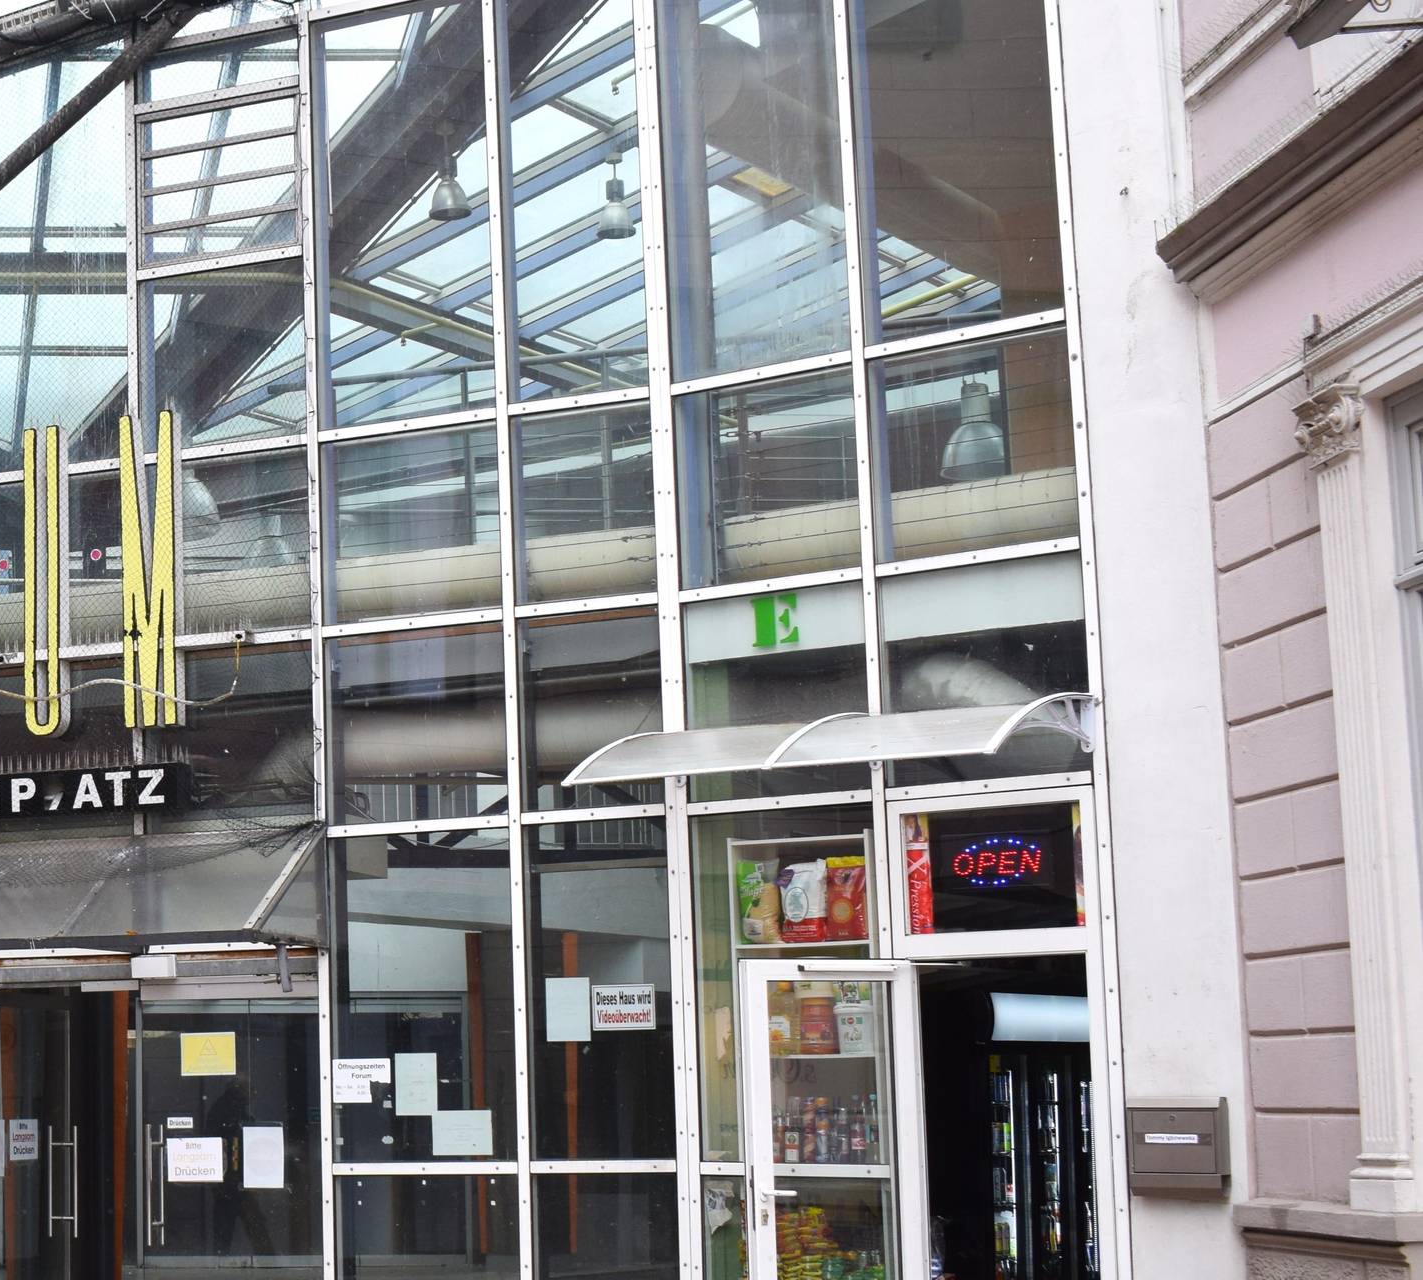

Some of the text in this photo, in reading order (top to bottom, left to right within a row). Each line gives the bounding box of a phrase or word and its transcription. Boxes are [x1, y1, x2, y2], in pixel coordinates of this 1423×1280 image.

[749, 592, 799, 648] E
[952, 848, 1042, 877] OPEN
[596, 990, 651, 1005] Dieses Haus wird
[597, 1009, 651, 1024] Videoüberwacht!
[337, 1062, 386, 1070] Öffnungszeiten
[185, 1142, 202, 1150] Bitte
[174, 1166, 216, 1176] Drücken
